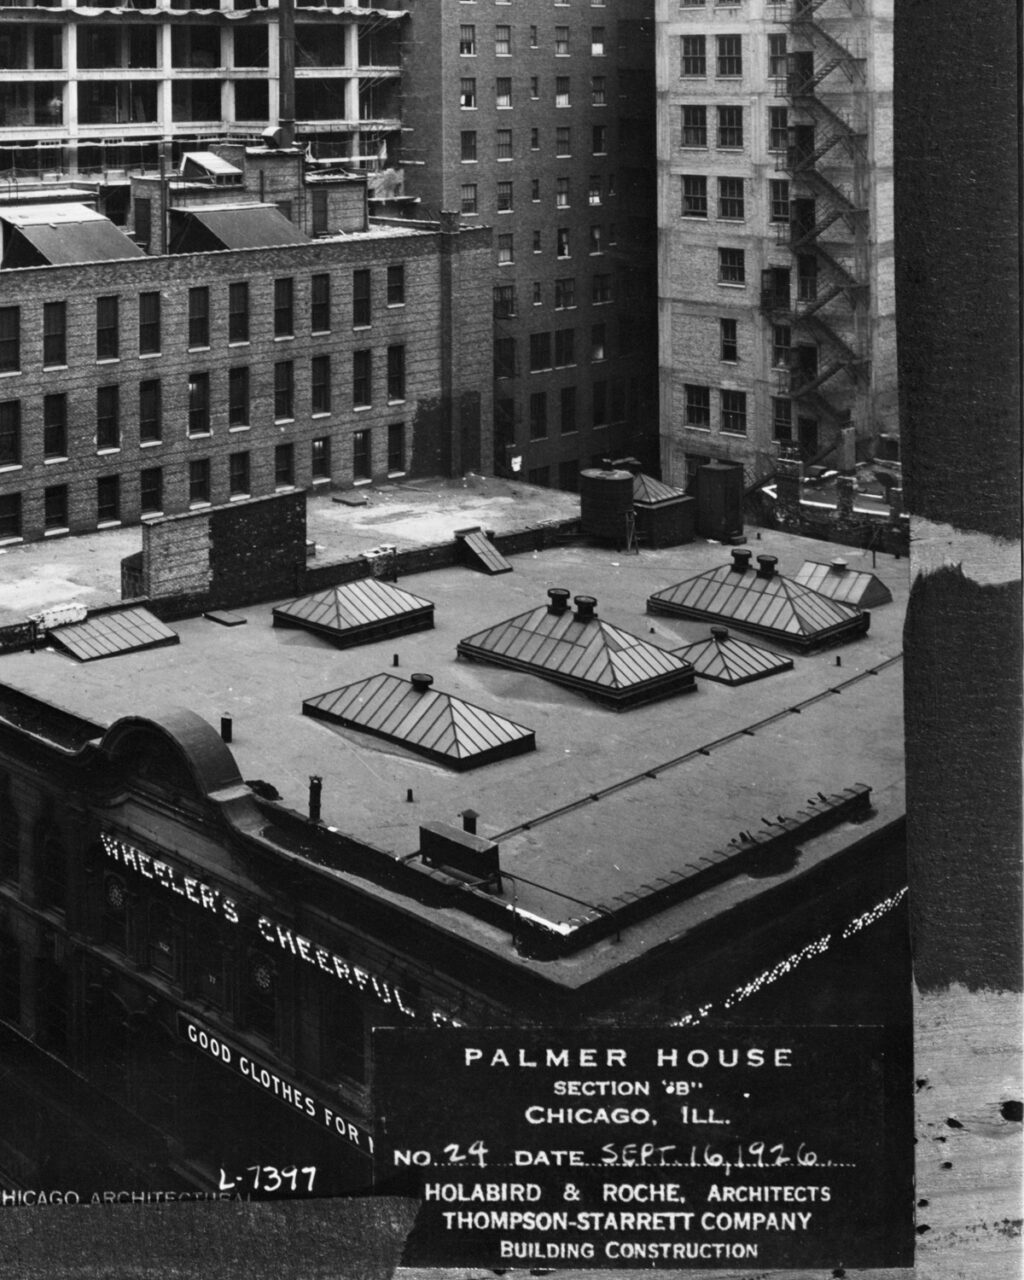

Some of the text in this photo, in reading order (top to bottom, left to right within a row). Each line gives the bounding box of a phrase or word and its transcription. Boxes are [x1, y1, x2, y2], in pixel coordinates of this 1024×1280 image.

[101, 832, 415, 1018] WHEELER'S CHEERFUL
[188, 1024, 231, 1063] GOOD
[240, 1057, 316, 1116] CLOTHES
[325, 1108, 359, 1144] FOR
